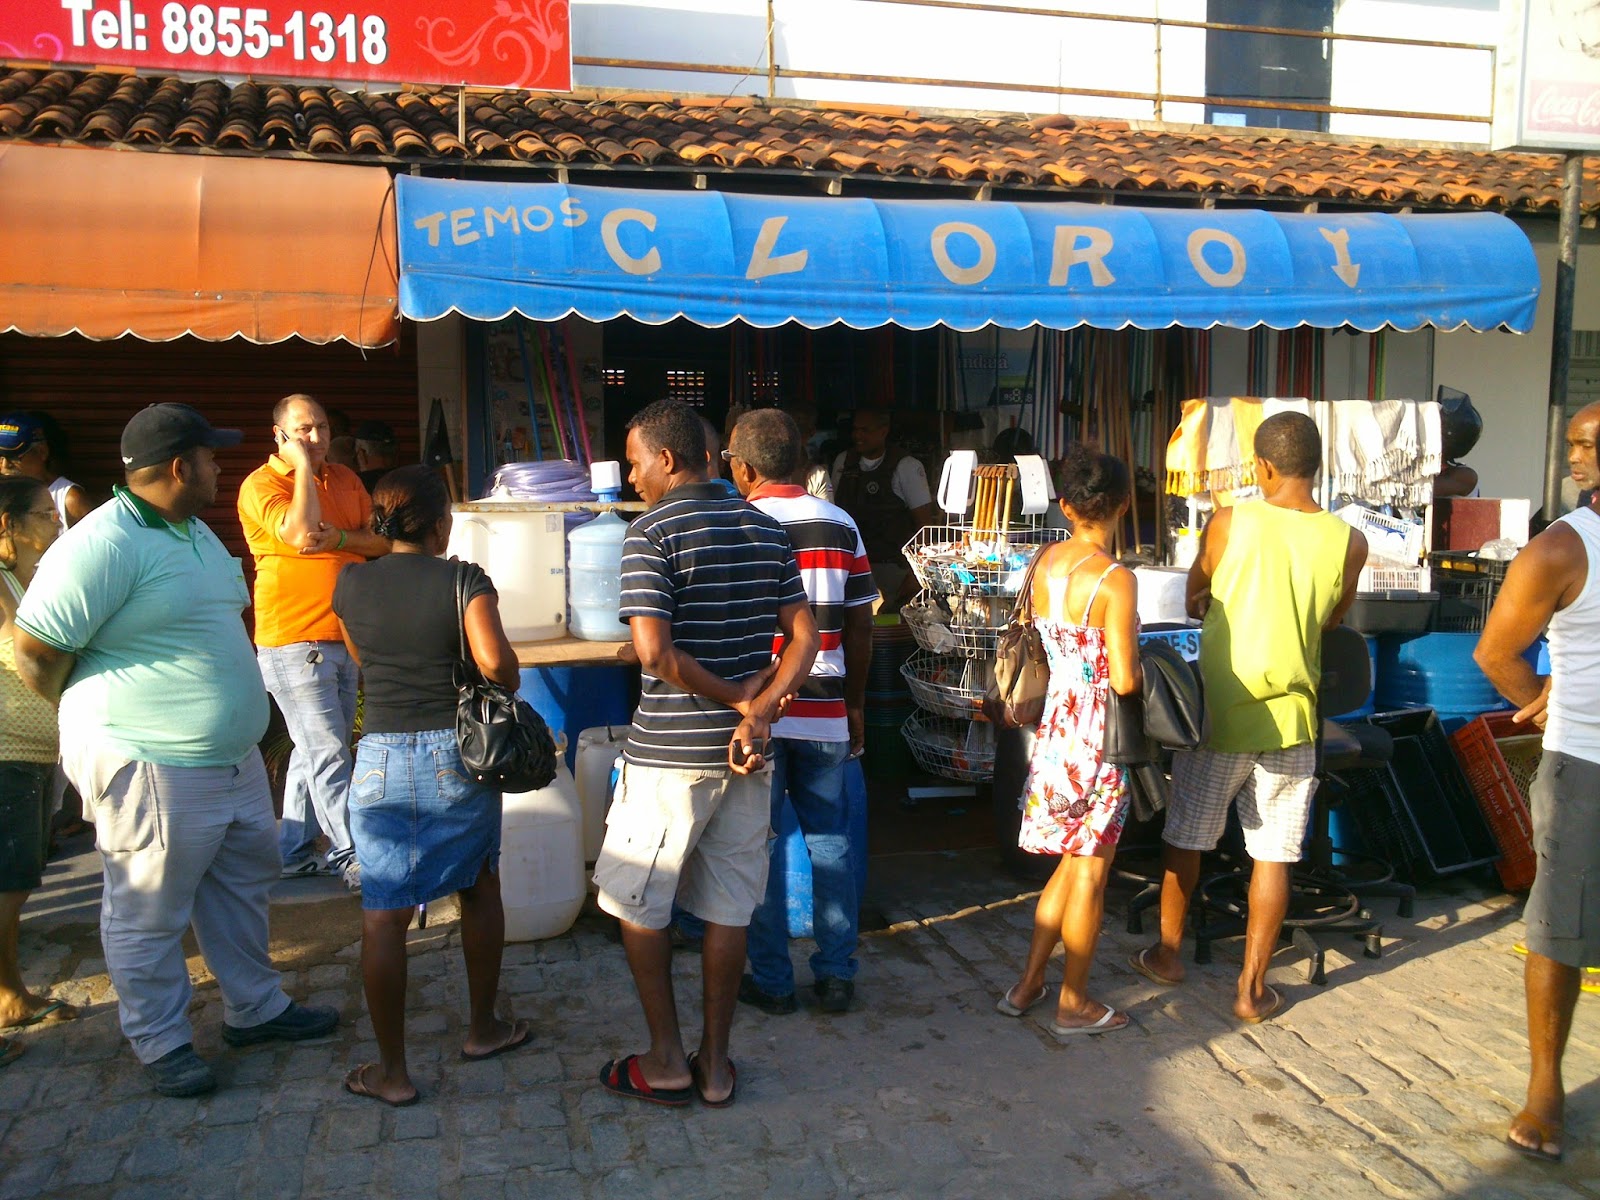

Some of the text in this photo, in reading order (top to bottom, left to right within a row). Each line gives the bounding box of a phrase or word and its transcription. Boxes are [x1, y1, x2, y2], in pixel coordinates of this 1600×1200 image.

[62, 0, 387, 65] Tel: 8855-1318
[415, 197, 1247, 288] TEMOS CLORO
